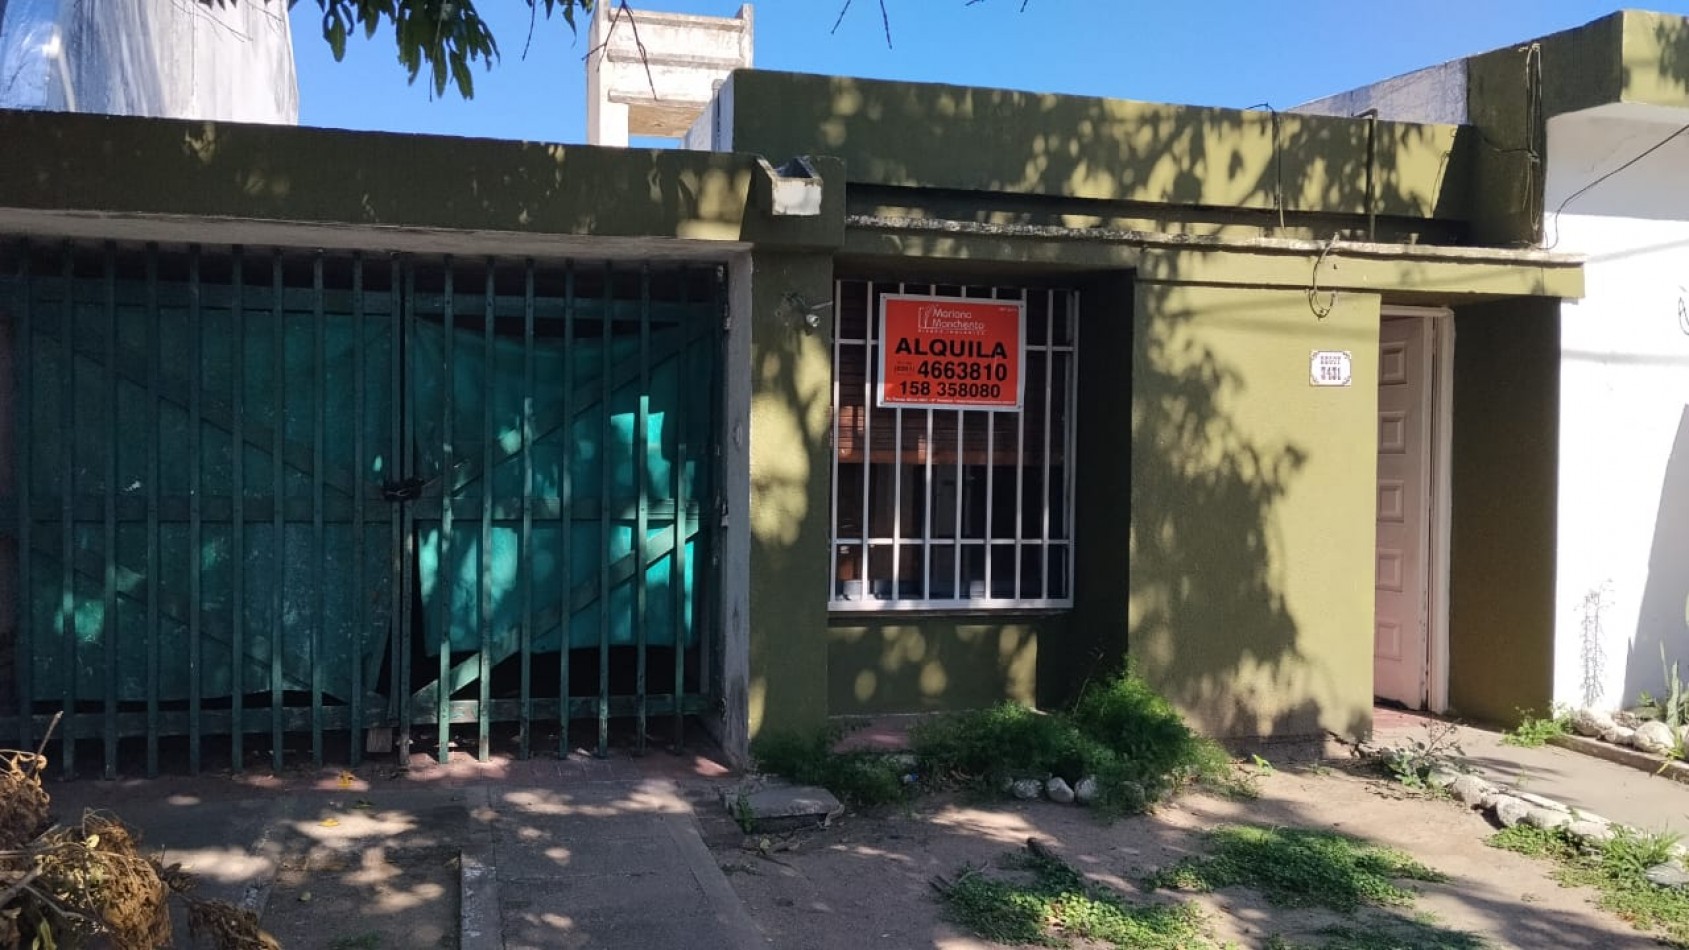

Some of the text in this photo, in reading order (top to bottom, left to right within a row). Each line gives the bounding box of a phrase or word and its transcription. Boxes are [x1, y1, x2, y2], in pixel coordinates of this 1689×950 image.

[895, 337, 1008, 359] ALQUILA
[917, 360, 1008, 382] 4663810
[899, 381, 1001, 398] 158 358080
